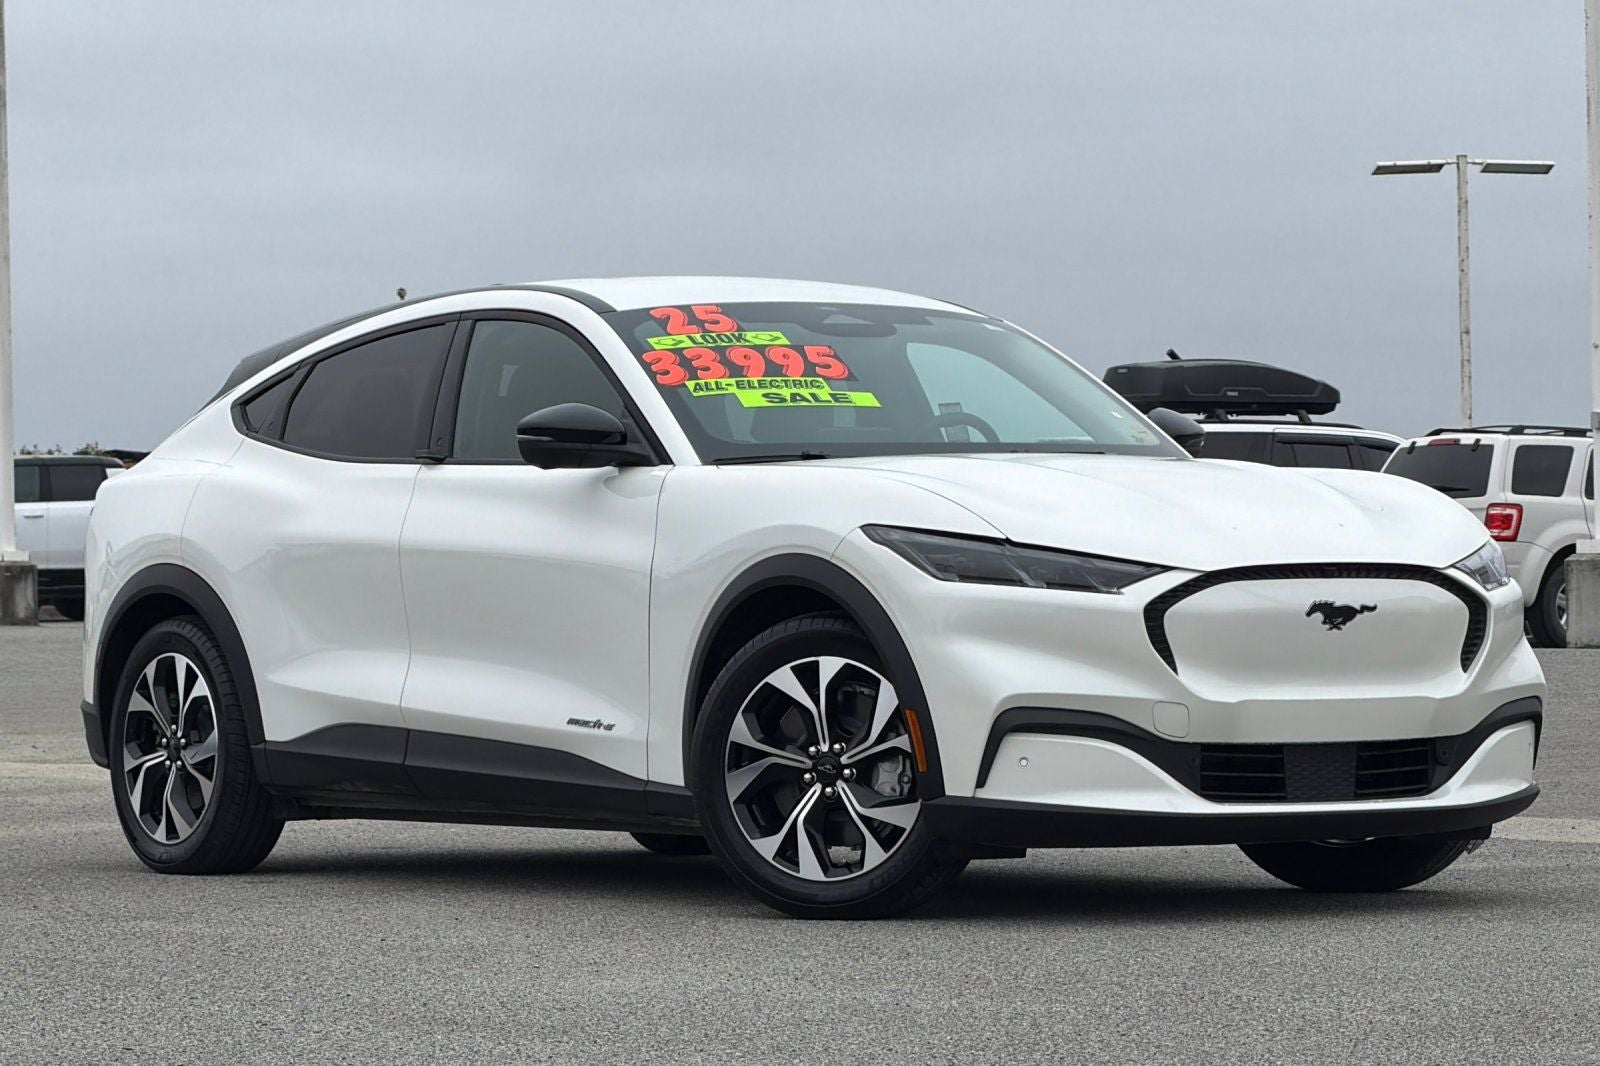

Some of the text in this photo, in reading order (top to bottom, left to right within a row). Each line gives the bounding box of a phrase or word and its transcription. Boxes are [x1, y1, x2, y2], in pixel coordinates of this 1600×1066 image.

[650, 304, 738, 335] 25
[686, 332, 750, 346] LOOK
[642, 345, 849, 387] 33995
[692, 379, 826, 393] ALL-ELECTRIC
[761, 392, 856, 404] SALE
